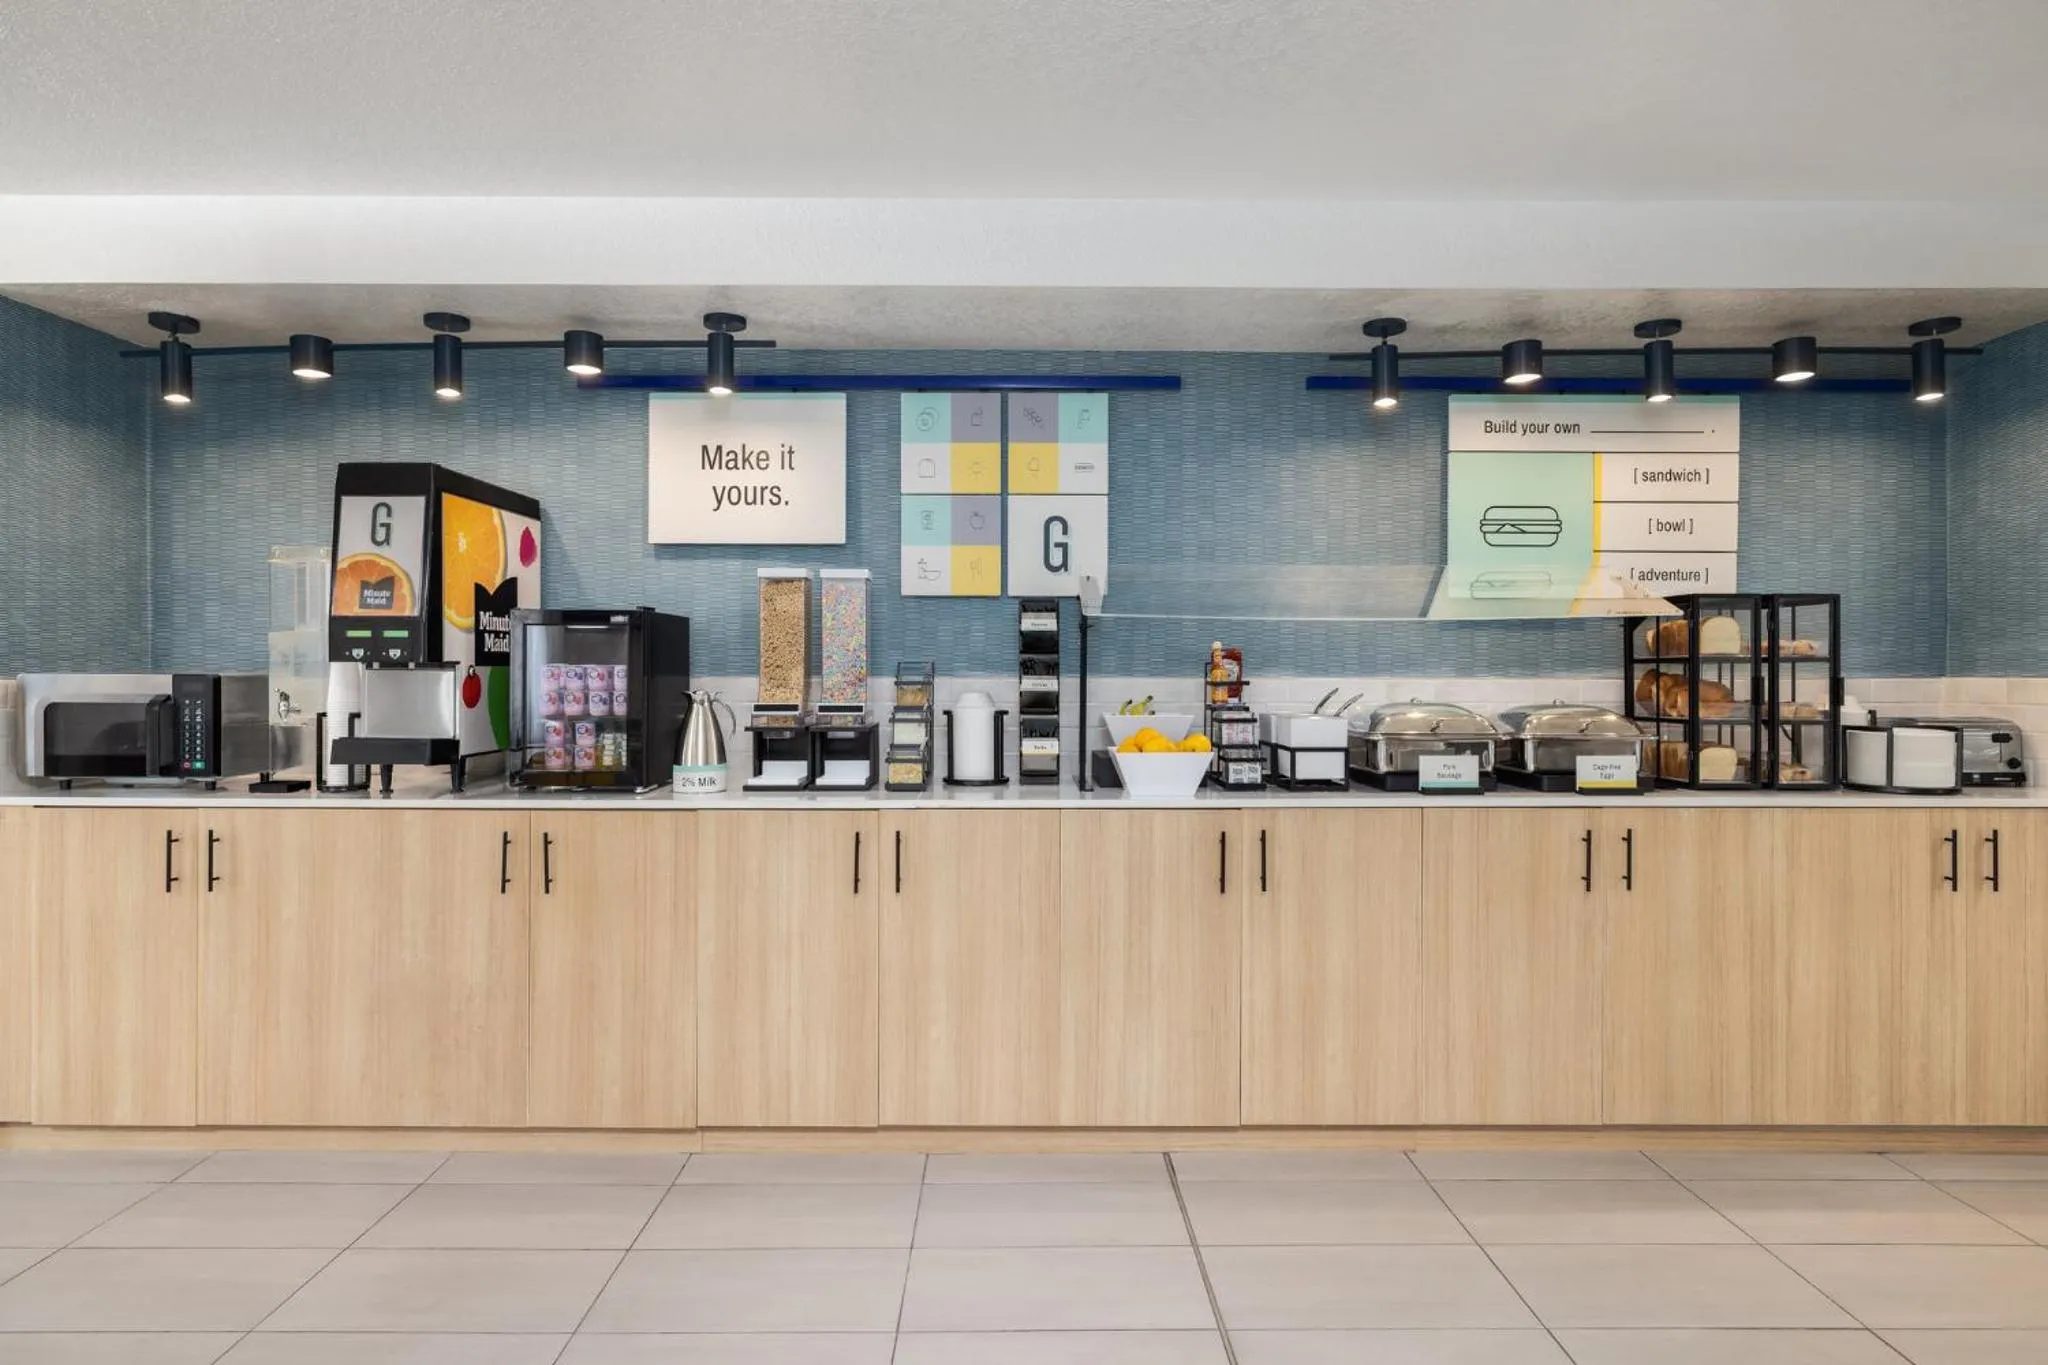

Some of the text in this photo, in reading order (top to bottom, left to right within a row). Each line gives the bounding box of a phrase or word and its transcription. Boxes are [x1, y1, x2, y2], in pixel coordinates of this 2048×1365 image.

[1484, 421, 1581, 437] Build your own
[701, 443, 796, 471] Make it
[1641, 468, 1702, 482] sandwich
[712, 485, 790, 512] yours.
[371, 502, 393, 547] G
[1656, 518, 1686, 532] bowl
[1044, 515, 1069, 573] G
[1638, 567, 1701, 582] adventure
[479, 611, 511, 632] Minut
[484, 632, 510, 652] Maid
[698, 776, 717, 787] Milk
